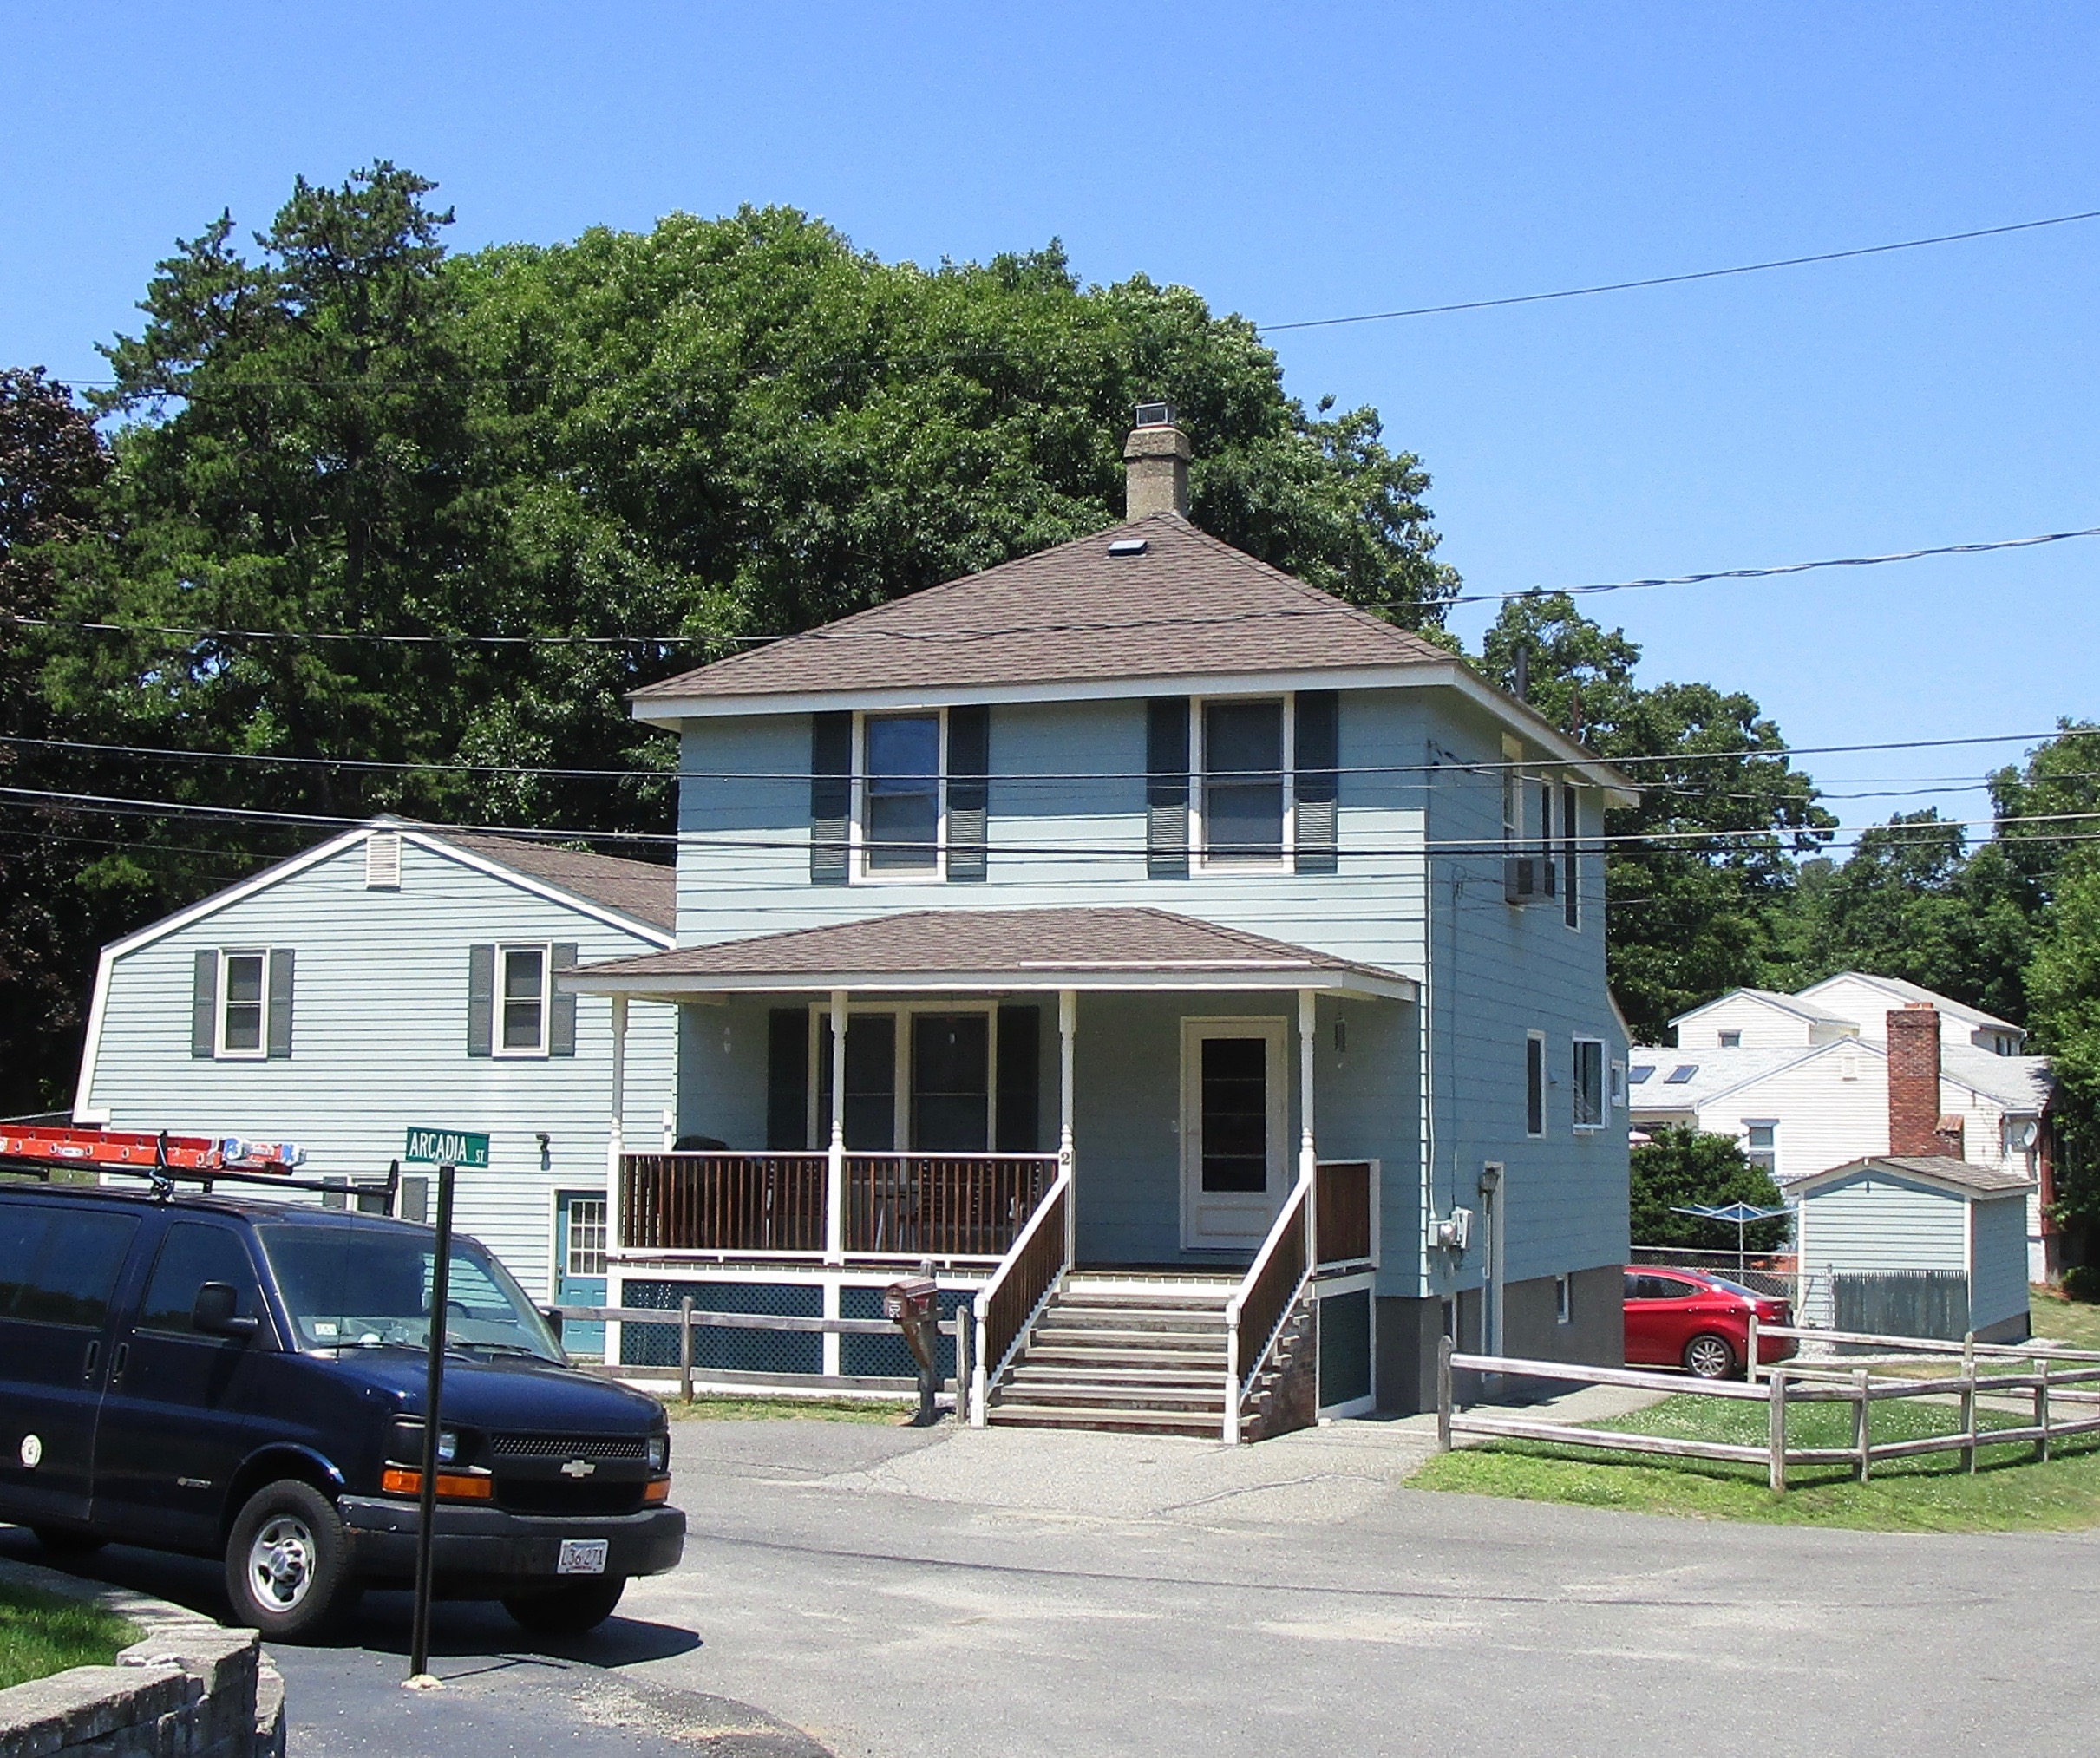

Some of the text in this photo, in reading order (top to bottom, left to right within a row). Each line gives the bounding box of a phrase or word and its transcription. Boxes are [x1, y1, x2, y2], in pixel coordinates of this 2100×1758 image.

[409, 1131, 485, 1163] ARCADIA ST
[1061, 1152, 1070, 1166] 2
